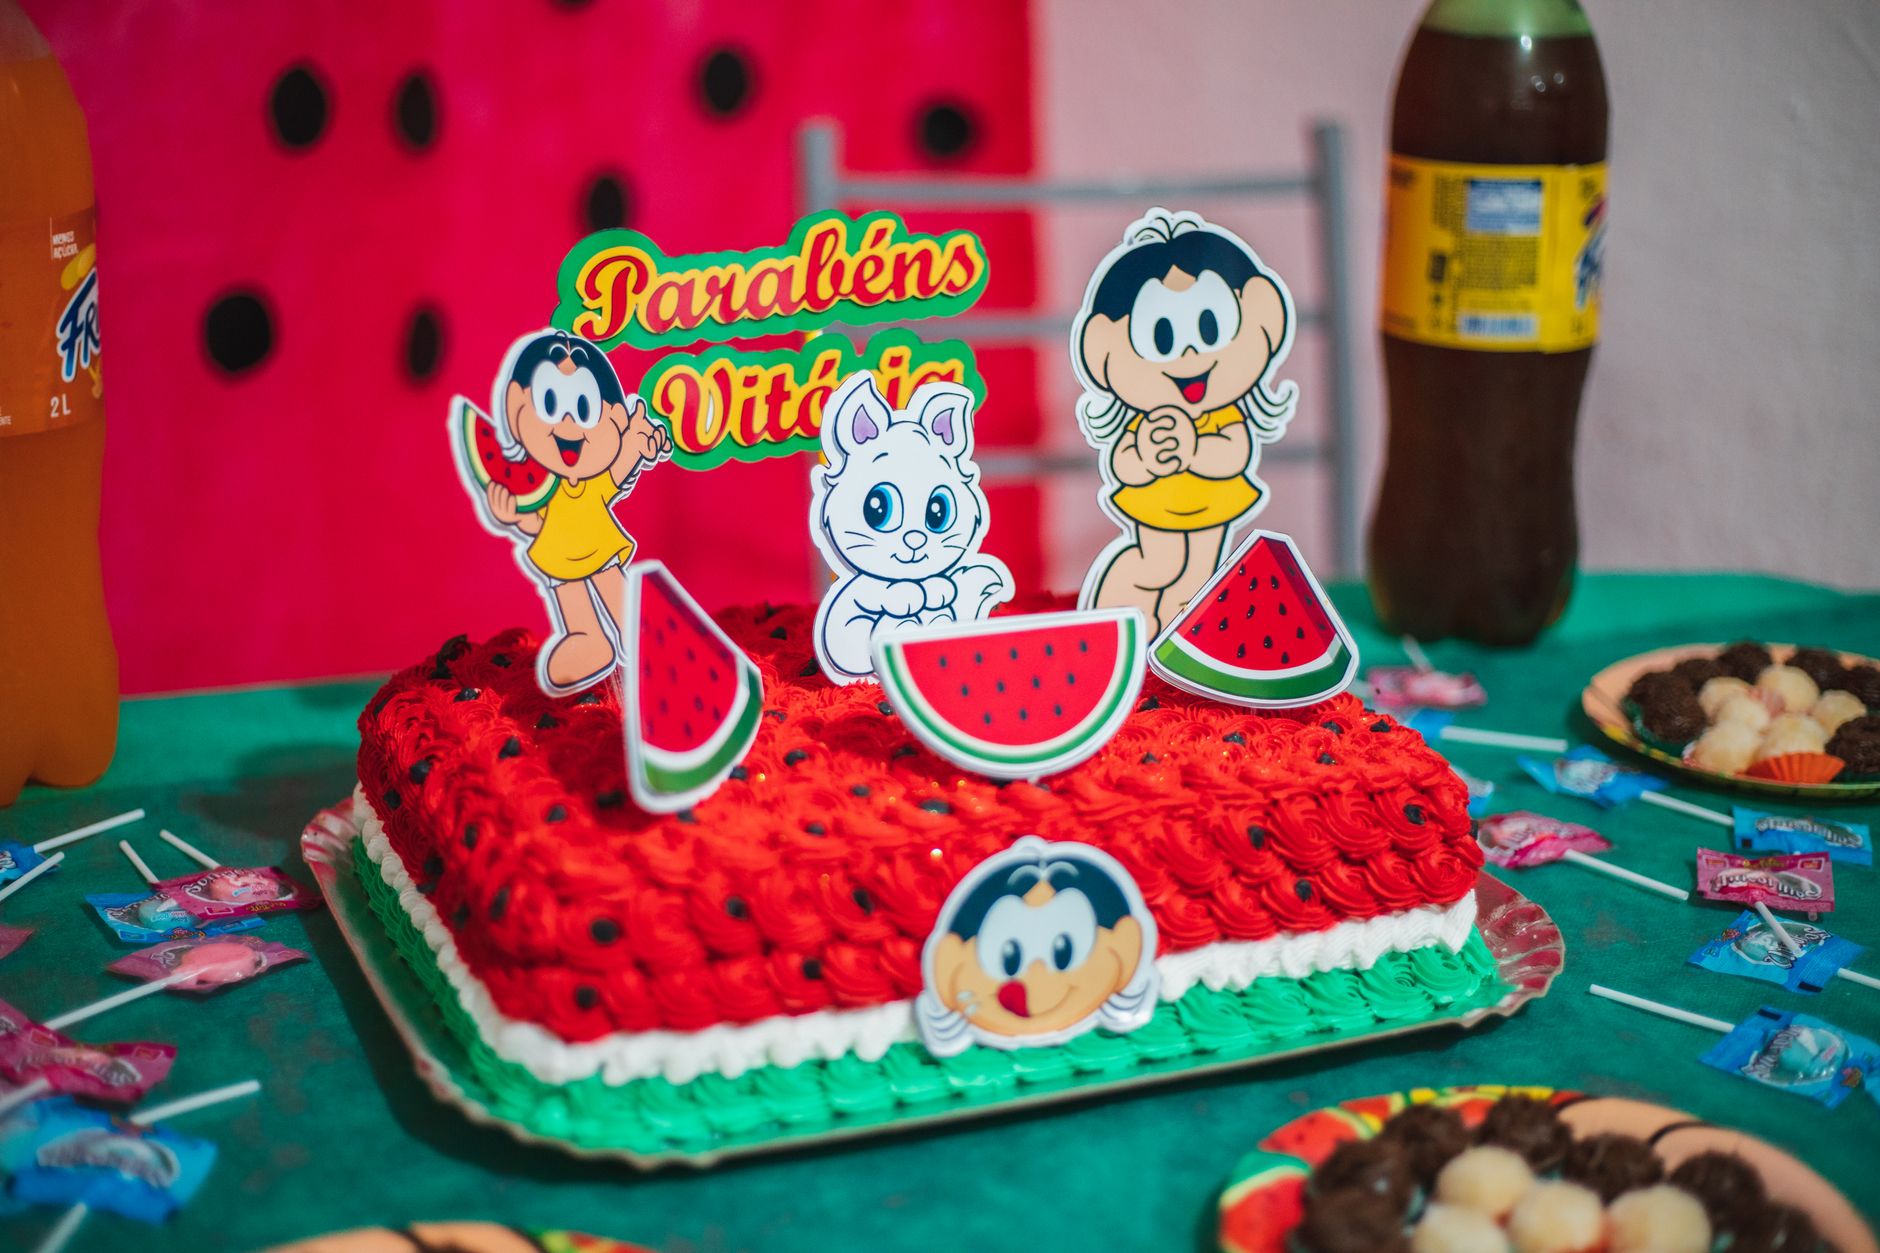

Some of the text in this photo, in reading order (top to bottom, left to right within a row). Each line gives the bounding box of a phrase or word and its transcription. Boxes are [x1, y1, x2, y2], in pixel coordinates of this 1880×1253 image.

[59, 268, 100, 378] FR
[575, 221, 982, 341] Parabéns
[655, 347, 964, 452] Vitói
